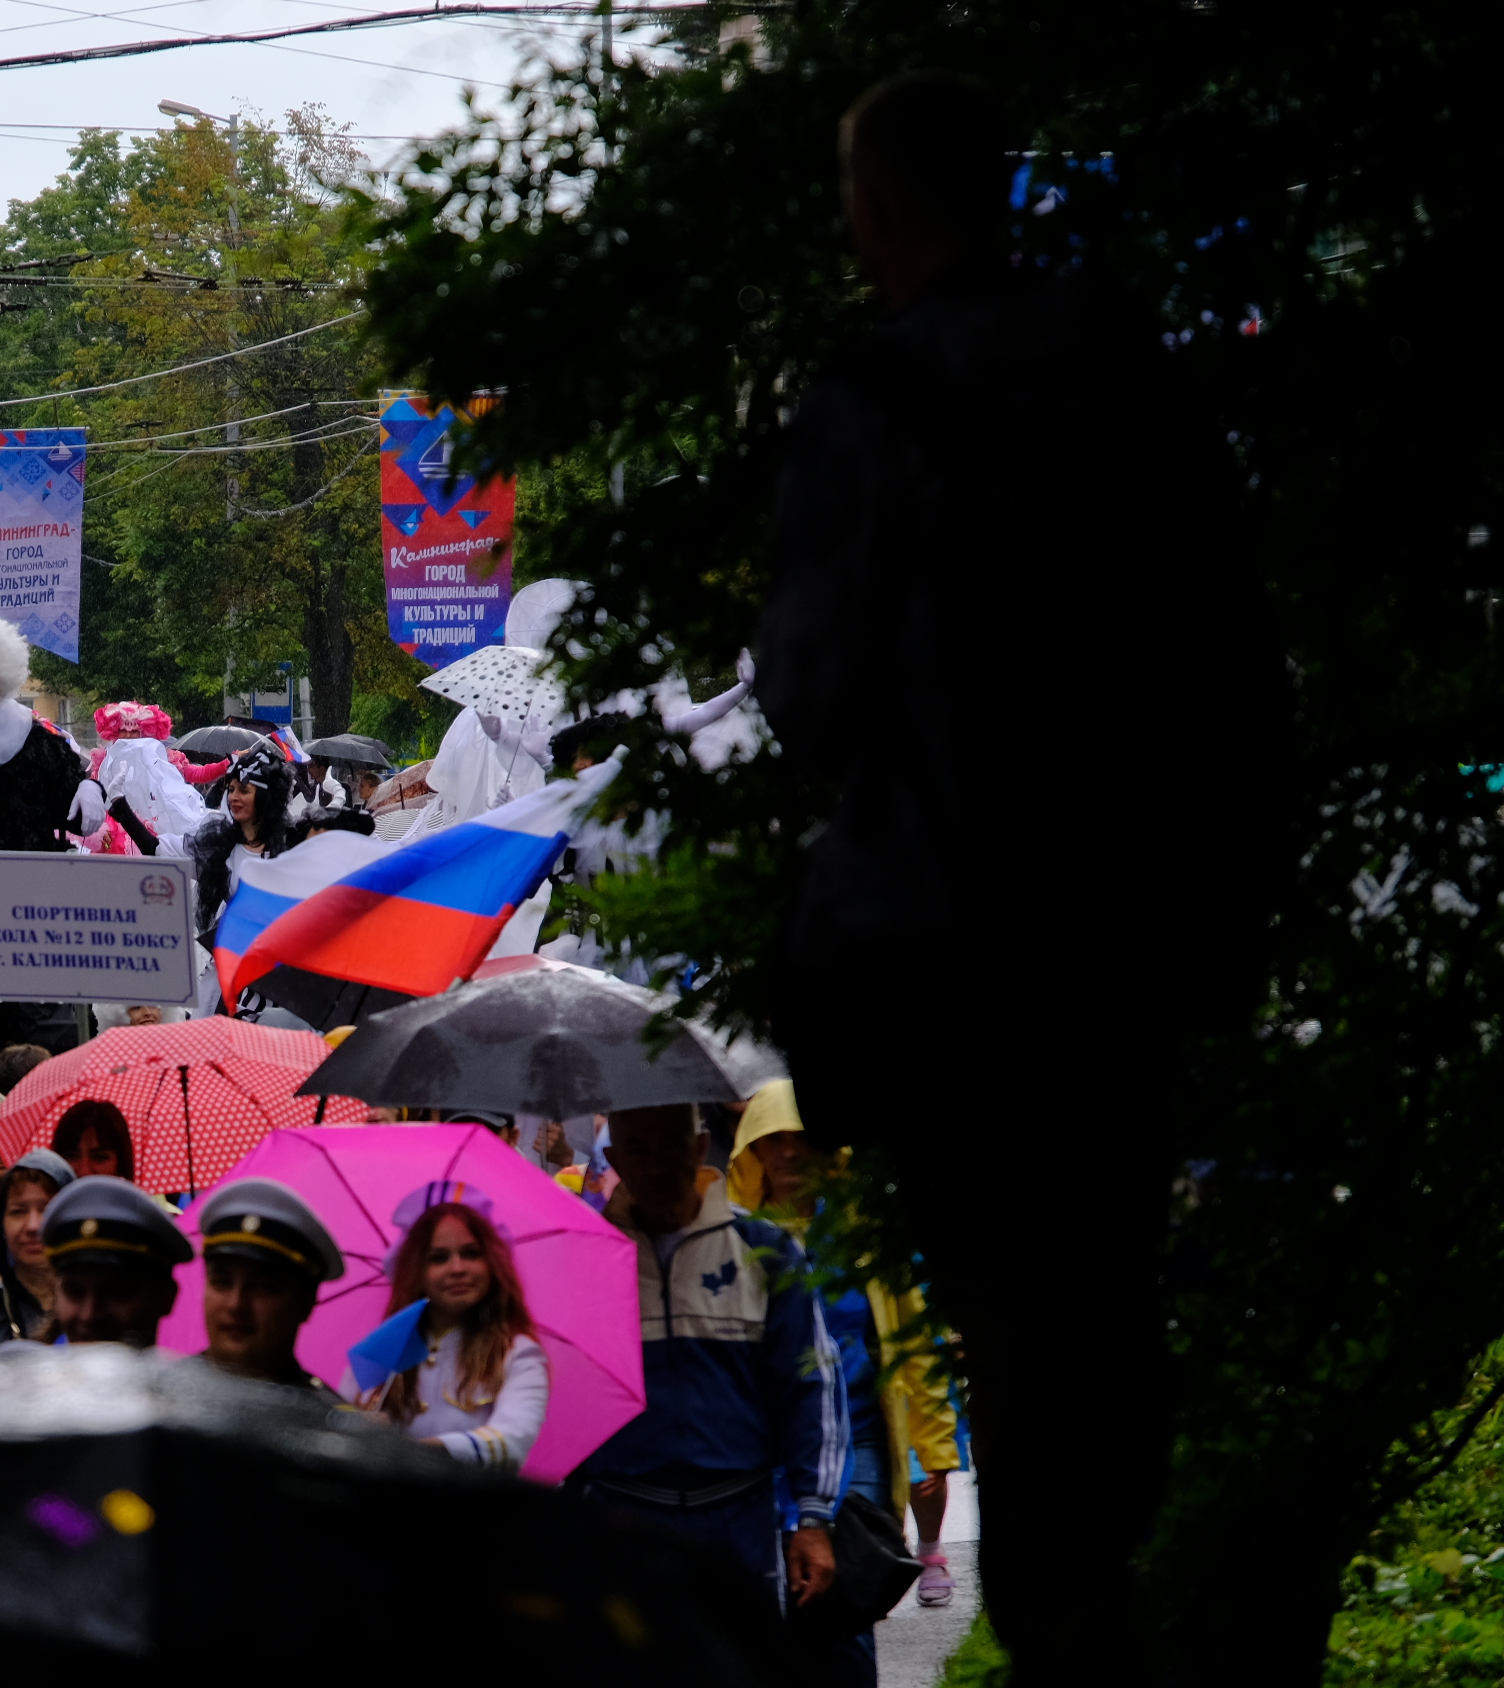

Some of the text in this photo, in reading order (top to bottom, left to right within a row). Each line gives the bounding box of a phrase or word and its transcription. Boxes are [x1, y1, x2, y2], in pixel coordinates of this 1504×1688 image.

[7, 545, 43, 560] ГОРОД
[52, 574, 60, 585] И
[426, 565, 465, 583] ГОРОД
[392, 584, 498, 601] МНОГОНАЦИОНАЛЬНОЙ
[405, 604, 484, 621] КУЛЬТУРЫ И
[412, 624, 476, 646] ТРАДИЦИЙ
[11, 905, 137, 923] СПОРТИВНАЯ
[45, 930, 84, 945] №12
[91, 931, 116, 947] ПО
[122, 932, 181, 949] БОКСУ
[12, 952, 161, 972] КАЛИНИНГРАДА
